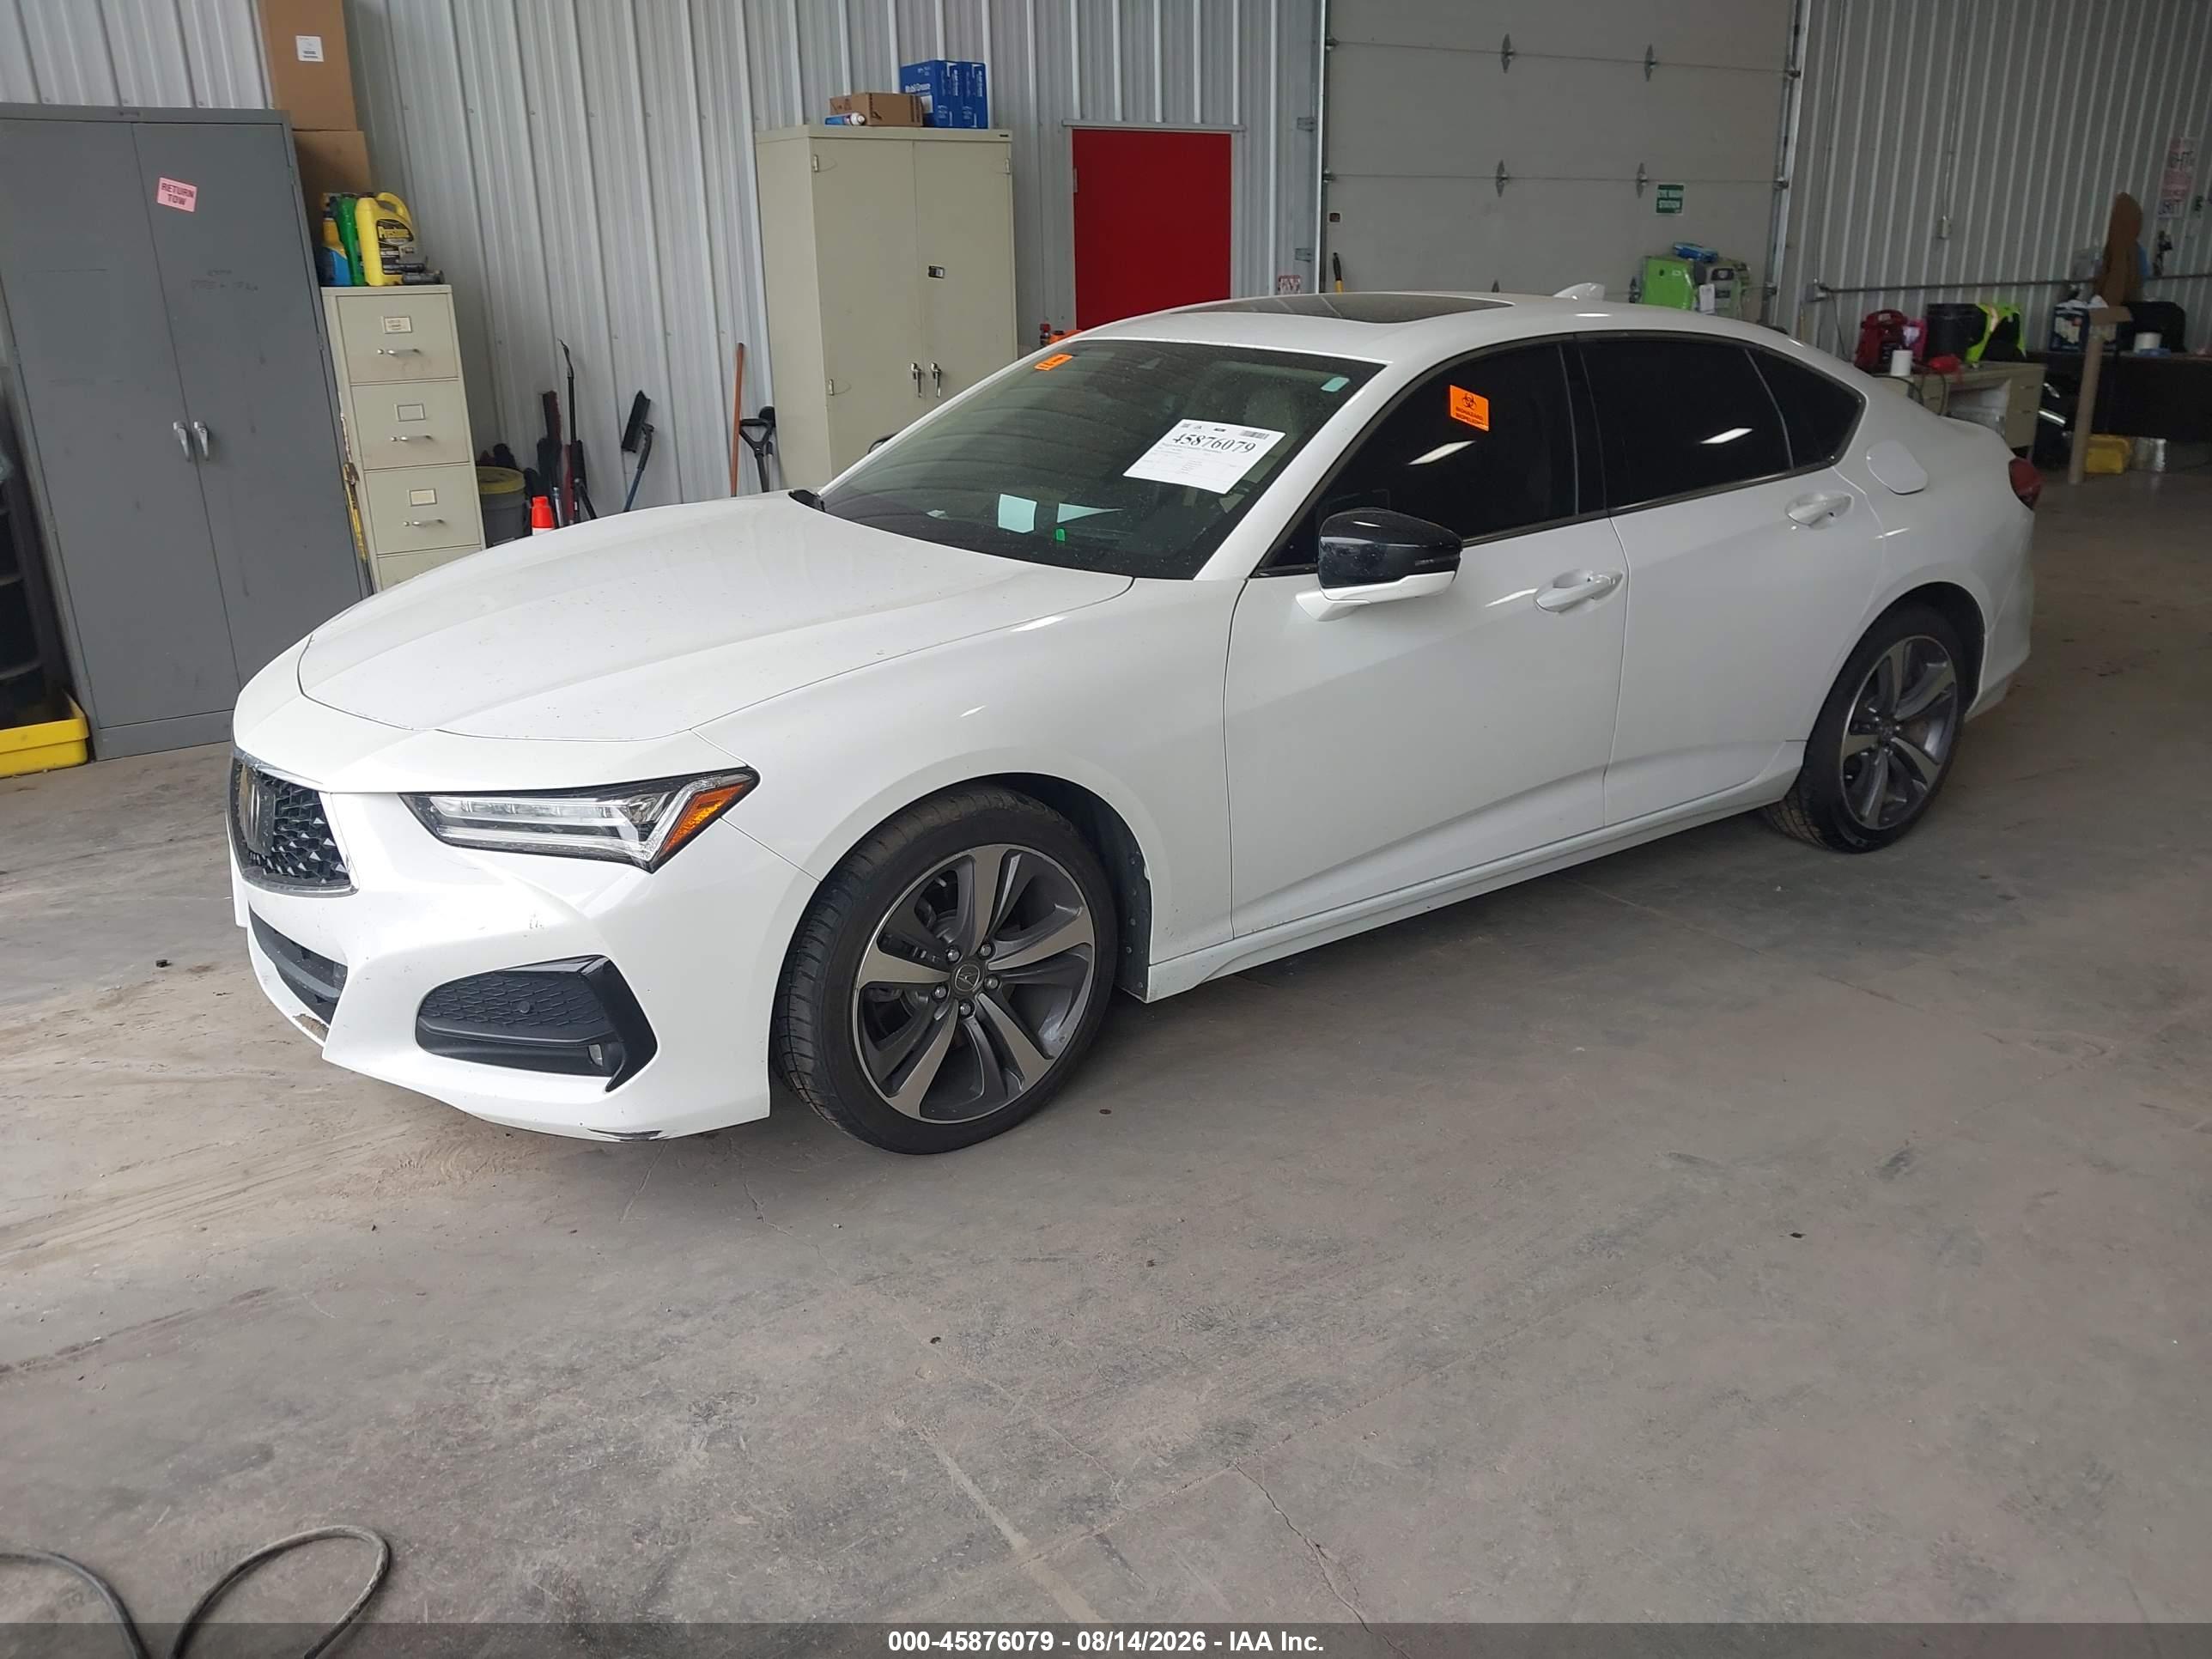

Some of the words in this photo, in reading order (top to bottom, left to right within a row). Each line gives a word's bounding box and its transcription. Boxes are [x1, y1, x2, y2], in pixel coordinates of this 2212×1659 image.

[161, 182, 195, 198] RETURN
[167, 193, 186, 206] TOW
[1172, 433, 1256, 453] 45876079
